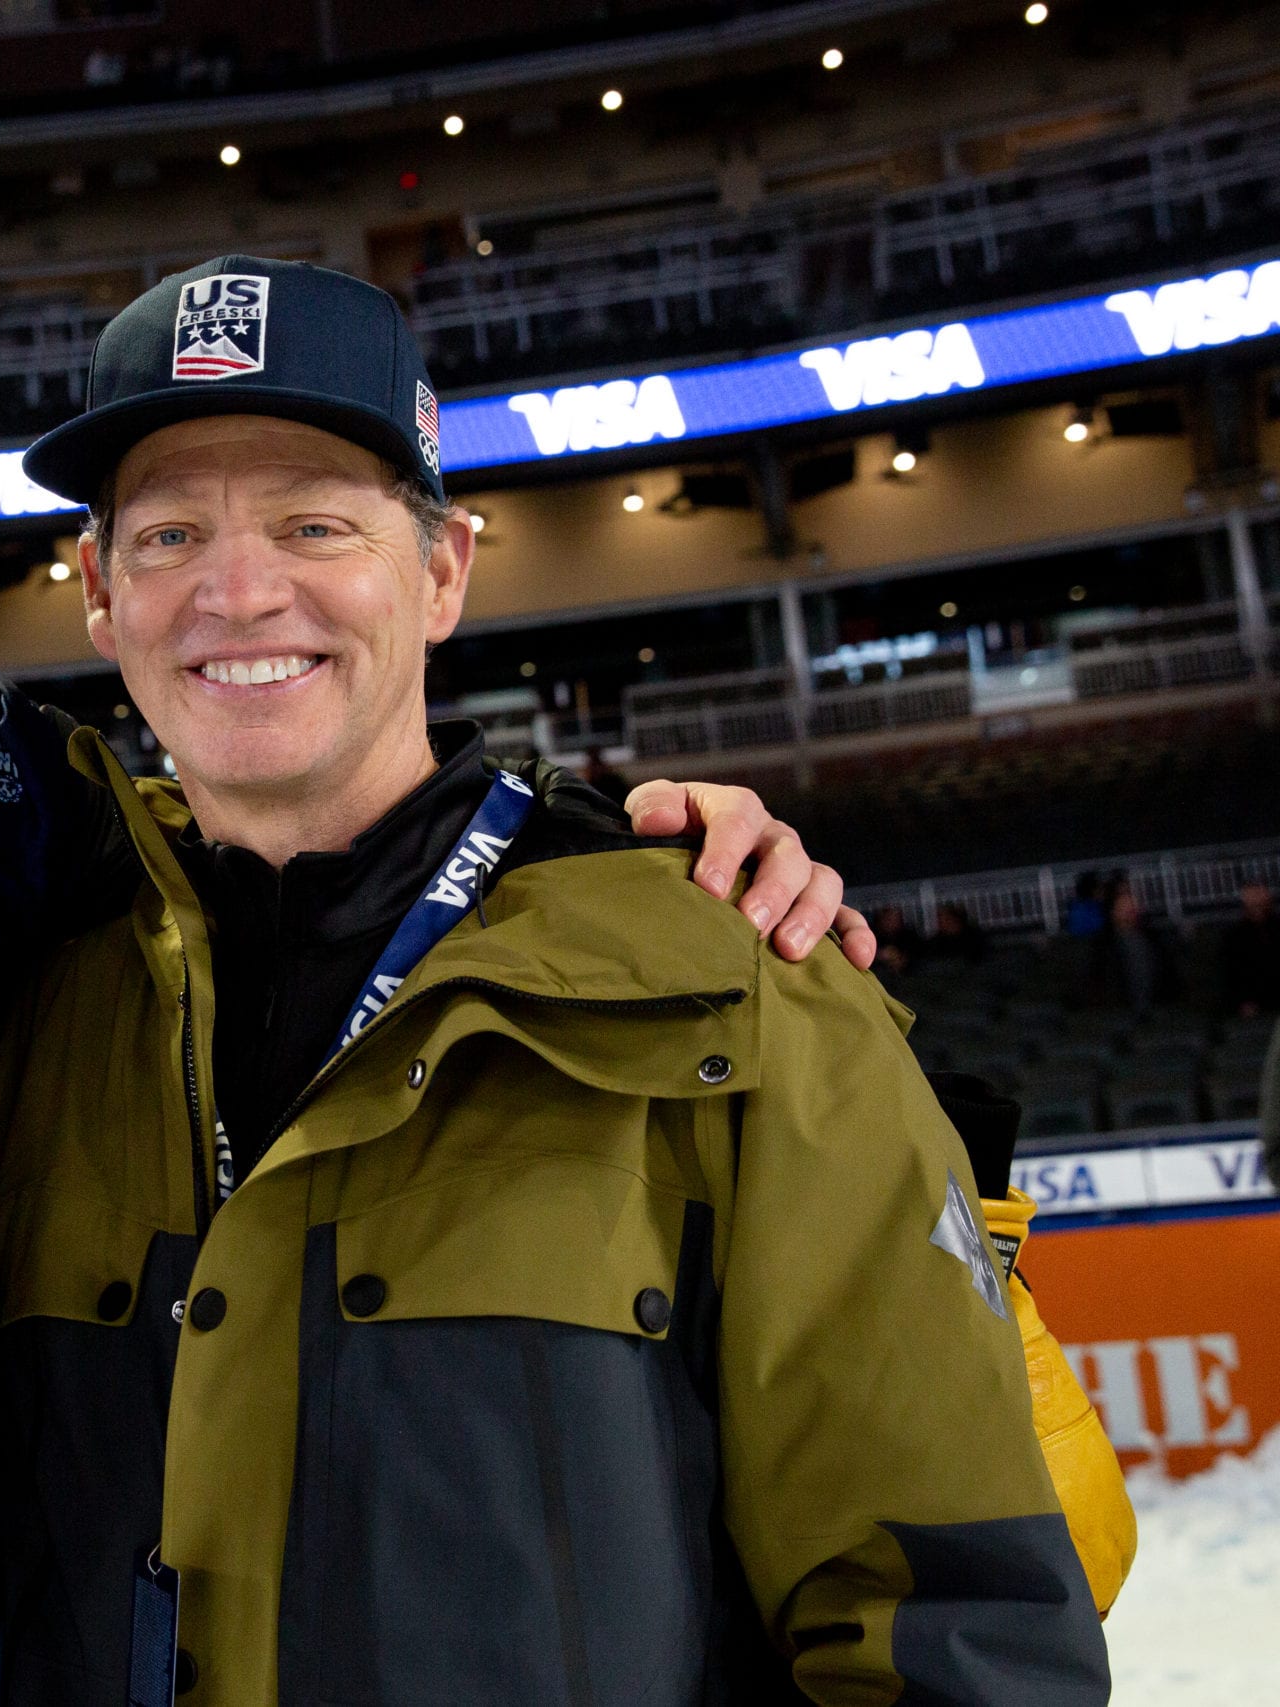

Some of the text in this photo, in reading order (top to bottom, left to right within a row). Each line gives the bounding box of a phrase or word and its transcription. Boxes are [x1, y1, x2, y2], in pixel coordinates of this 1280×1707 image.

[179, 307, 261, 326] FREESKI
[183, 279, 261, 312] US
[800, 323, 985, 411] VISA
[508, 375, 685, 455] VISA
[424, 831, 514, 910] VISA
[1015, 1163, 1098, 1202] ISA
[991, 1238, 1018, 1252] UALITY
[1061, 1332, 1251, 1450] HE
